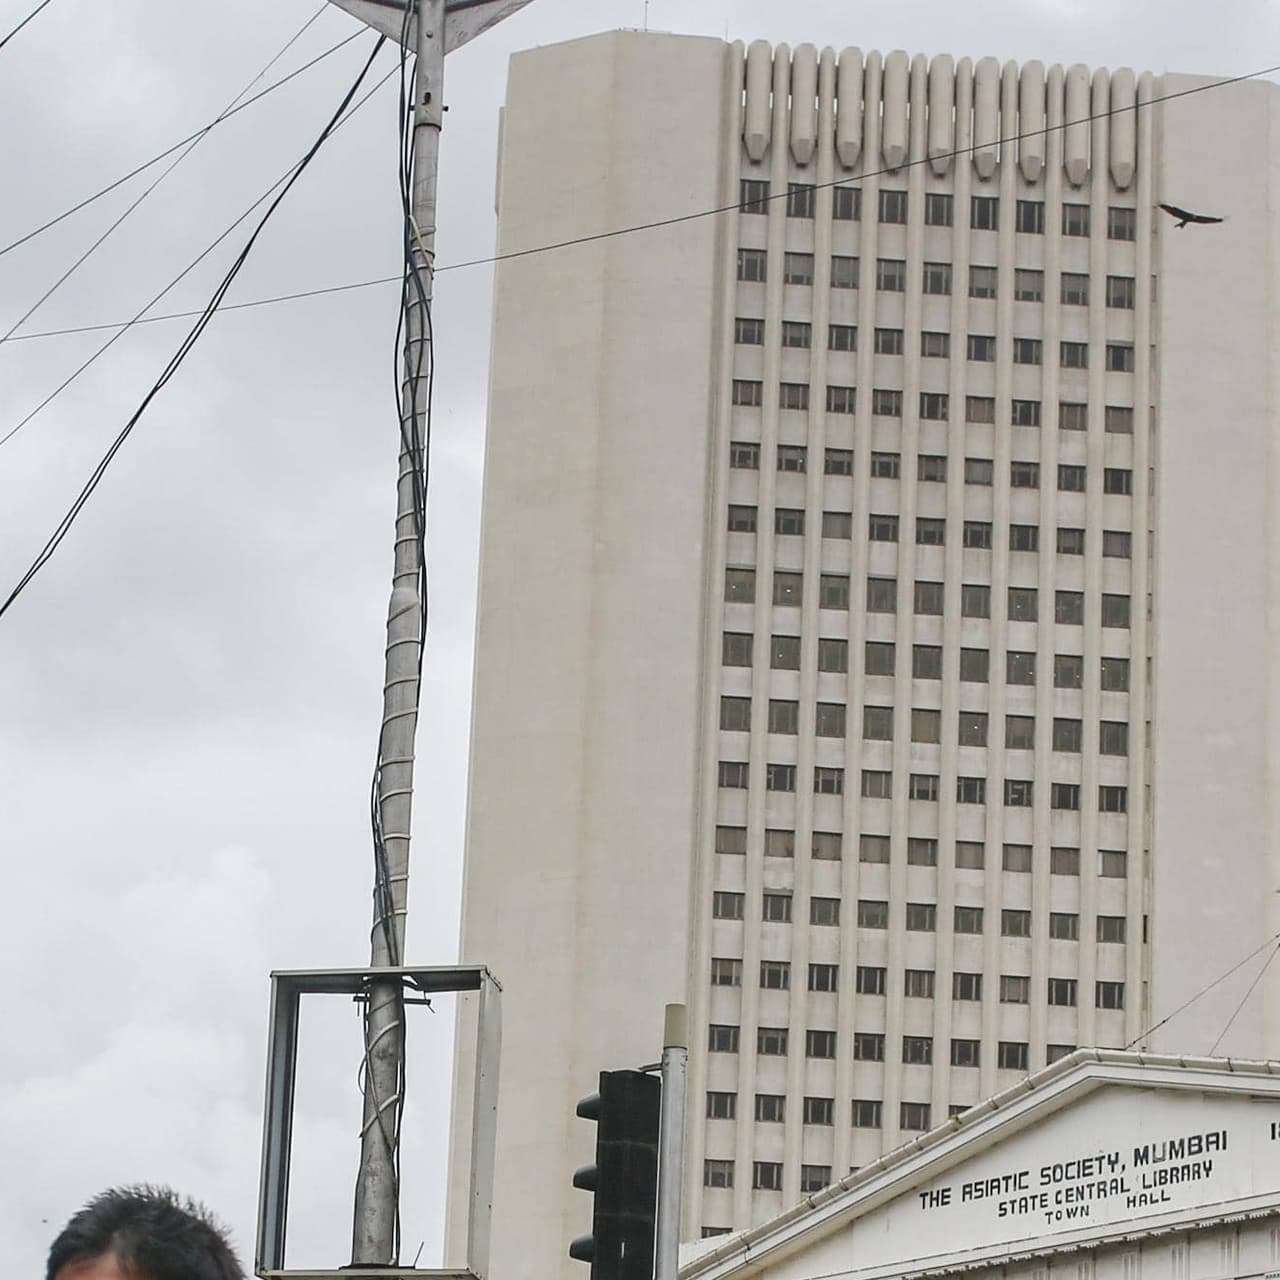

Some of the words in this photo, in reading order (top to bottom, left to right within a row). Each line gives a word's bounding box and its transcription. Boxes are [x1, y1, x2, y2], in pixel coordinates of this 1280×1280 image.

[920, 1188, 951, 1210] THE
[962, 1171, 1029, 1202] ASIATIC
[1040, 1151, 1126, 1186] SOCIETY,
[1134, 1130, 1227, 1167] MUMBAI
[998, 1193, 1048, 1217] STATE
[1055, 1177, 1131, 1205] CENTRAL
[1142, 1160, 1213, 1189] LIBRARY
[1045, 1205, 1090, 1224] TOWN
[1126, 1190, 1171, 1208] HALL
